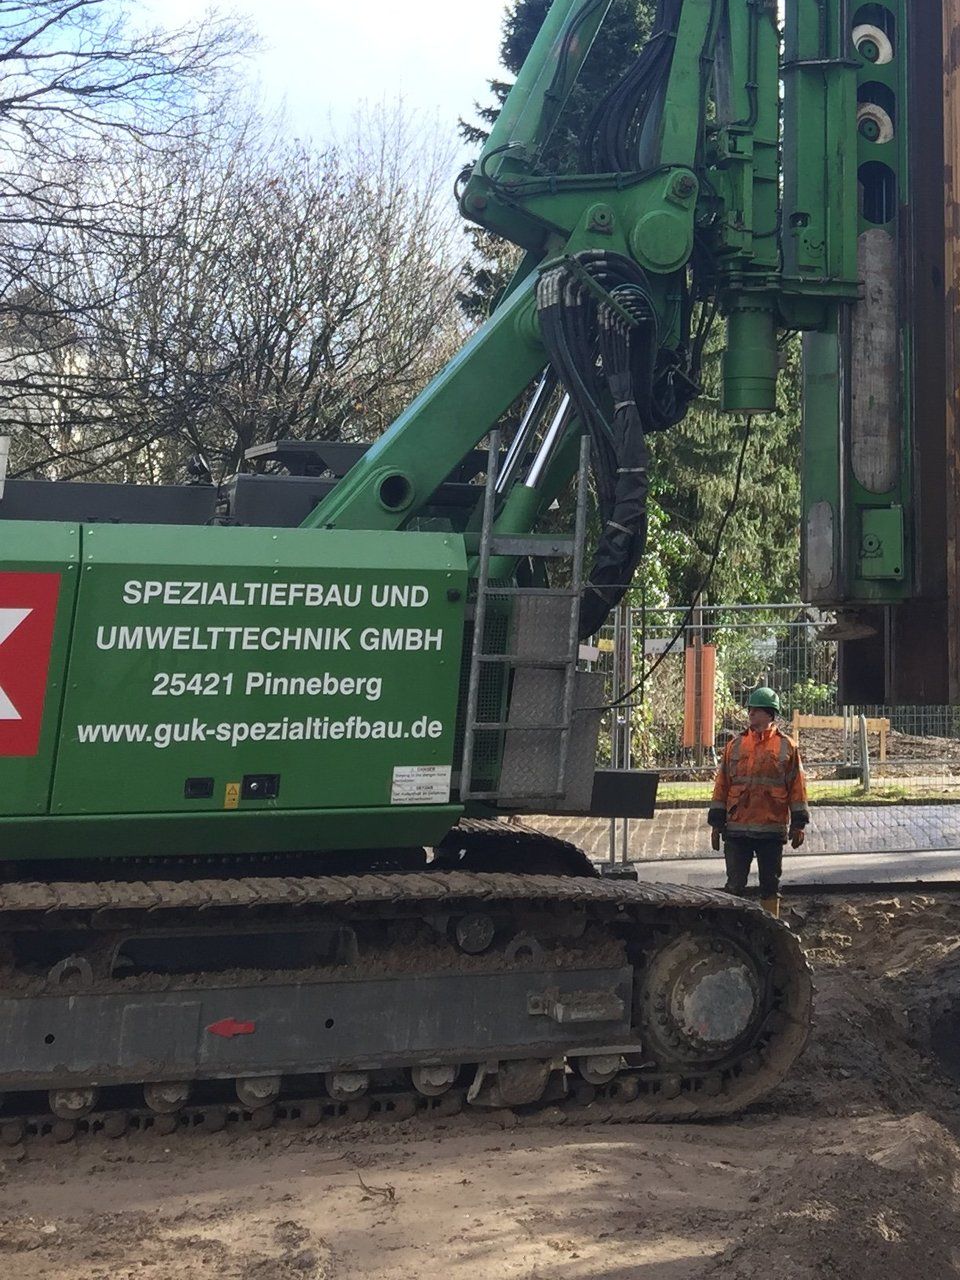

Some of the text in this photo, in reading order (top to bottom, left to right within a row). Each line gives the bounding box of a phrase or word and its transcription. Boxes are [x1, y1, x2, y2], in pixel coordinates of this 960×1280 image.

[122, 580, 429, 607] SPEZIALTIEFBAU UND
[96, 626, 443, 651] UMWELTTECHNIK GMBH
[152, 672, 382, 701] 25421 Pinneberg
[77, 716, 443, 748] www.guk-spezialtiefbau.de
